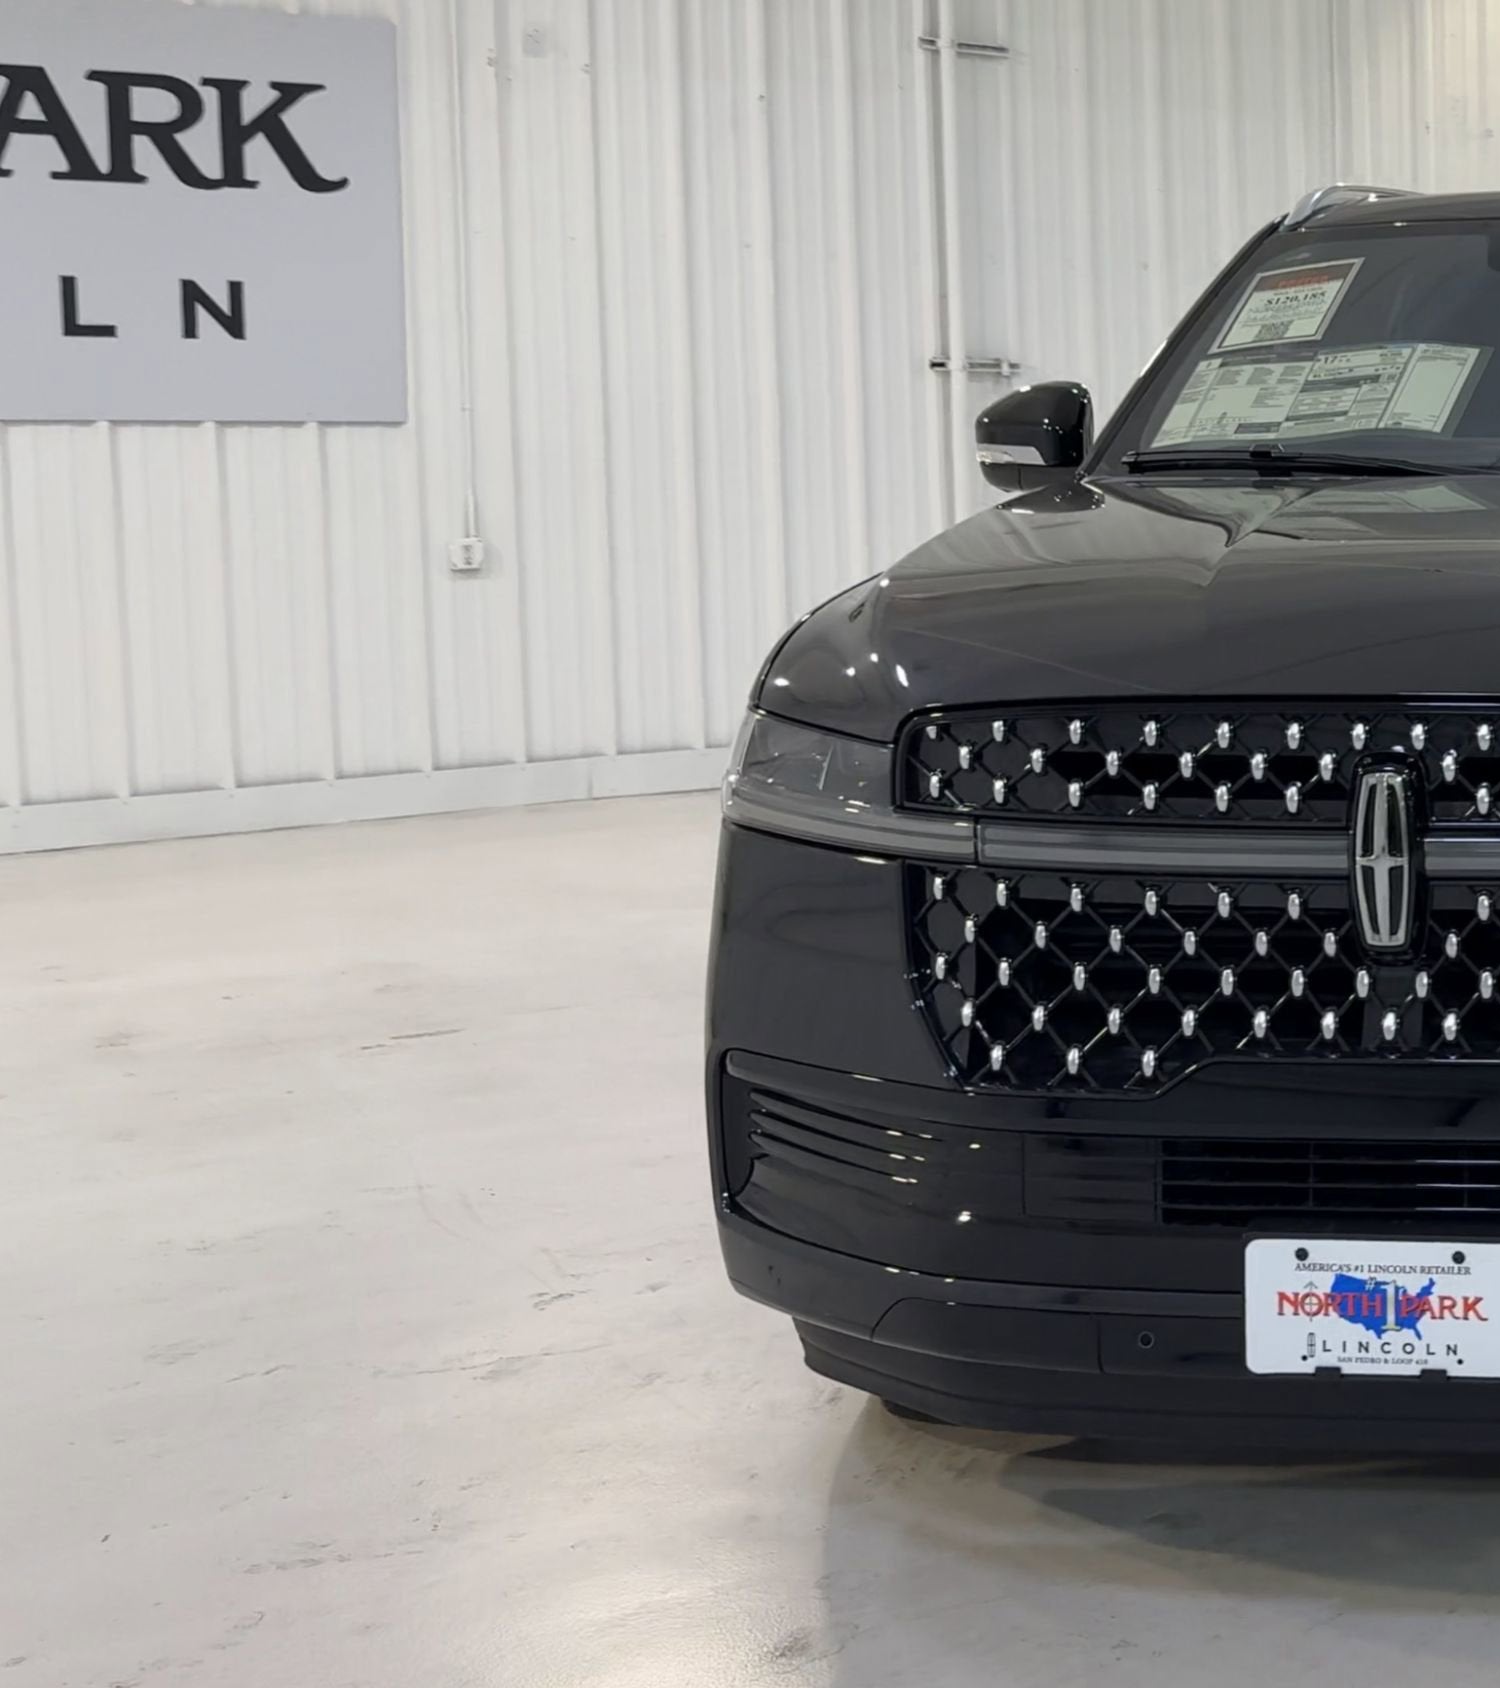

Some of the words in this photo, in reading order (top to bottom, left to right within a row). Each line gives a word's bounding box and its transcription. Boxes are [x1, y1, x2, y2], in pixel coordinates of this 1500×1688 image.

[1294, 1262, 1352, 1273] AMERICA'S
[1353, 1265, 1365, 1273] #1
[1367, 1265, 1419, 1275] LINCOLN
[1420, 1266, 1472, 1275] RETAILER
[1276, 1291, 1383, 1317] NORTH
[1400, 1292, 1489, 1322] PARK
[1322, 1340, 1459, 1356] LINCOLN
